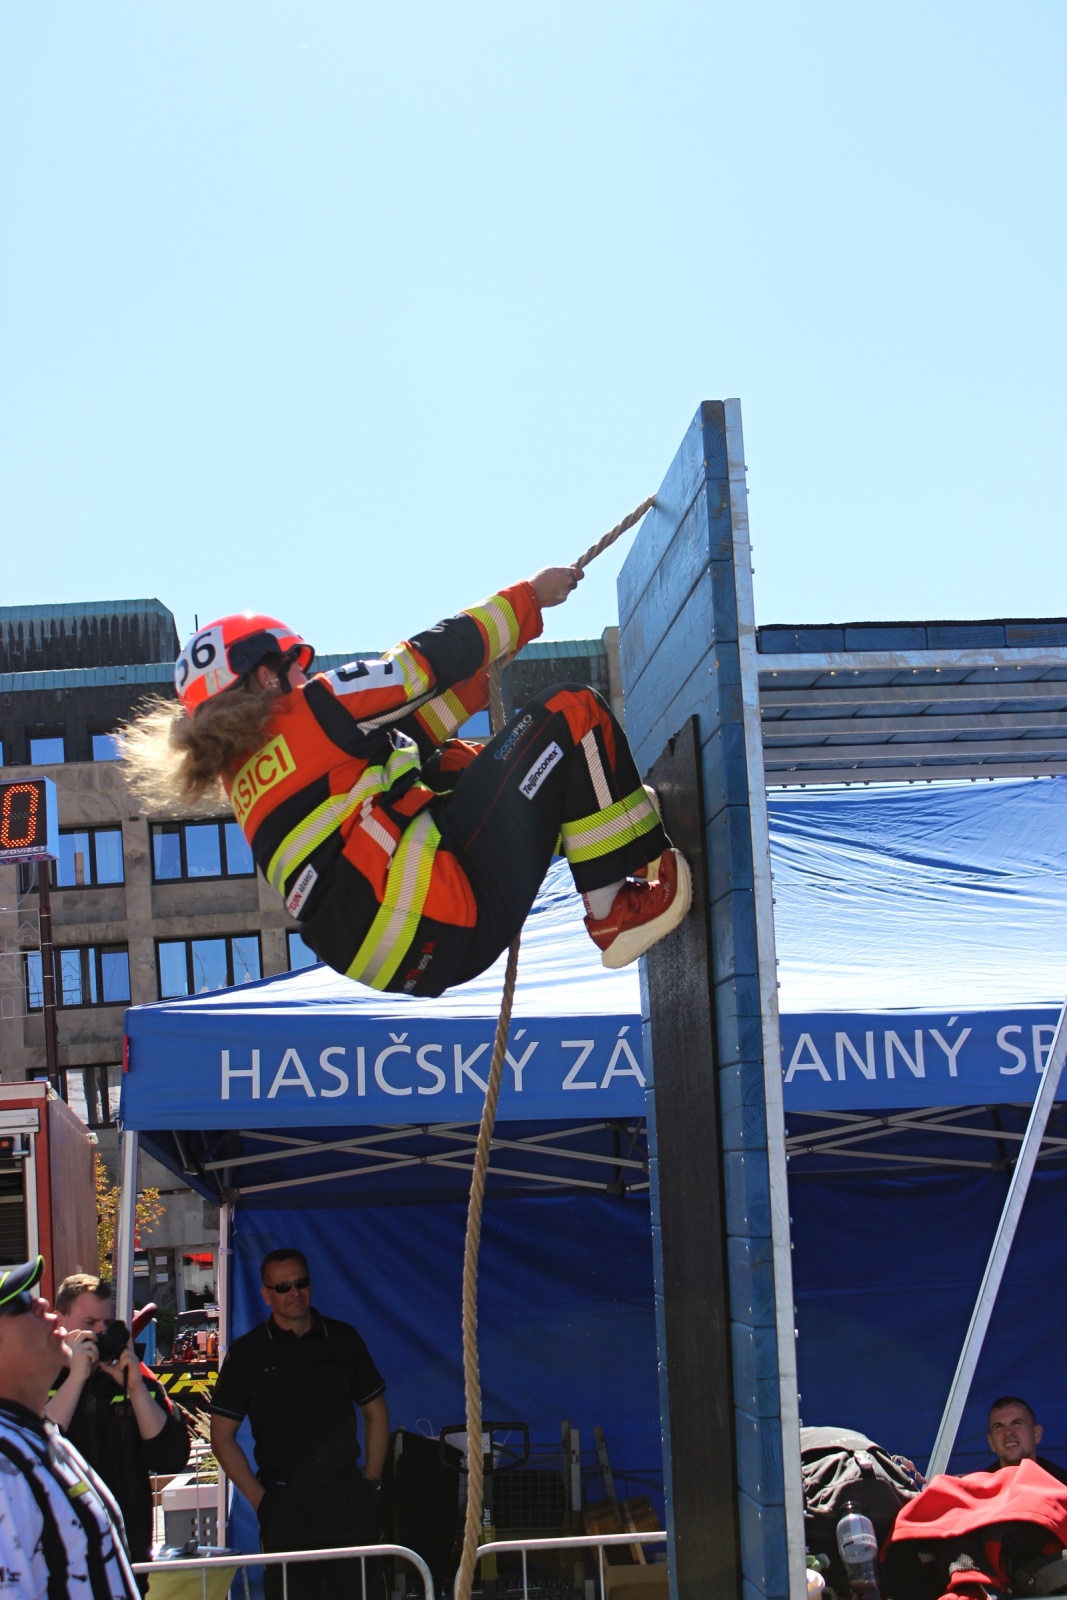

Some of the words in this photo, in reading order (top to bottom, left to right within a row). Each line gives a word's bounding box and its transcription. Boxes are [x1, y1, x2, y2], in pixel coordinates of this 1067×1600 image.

[1, 784, 39, 848] 0
[233, 745, 288, 821] ASIČI
[591, 926, 619, 936] SALOMON
[221, 1029, 539, 1099] HASIČSKÝ
